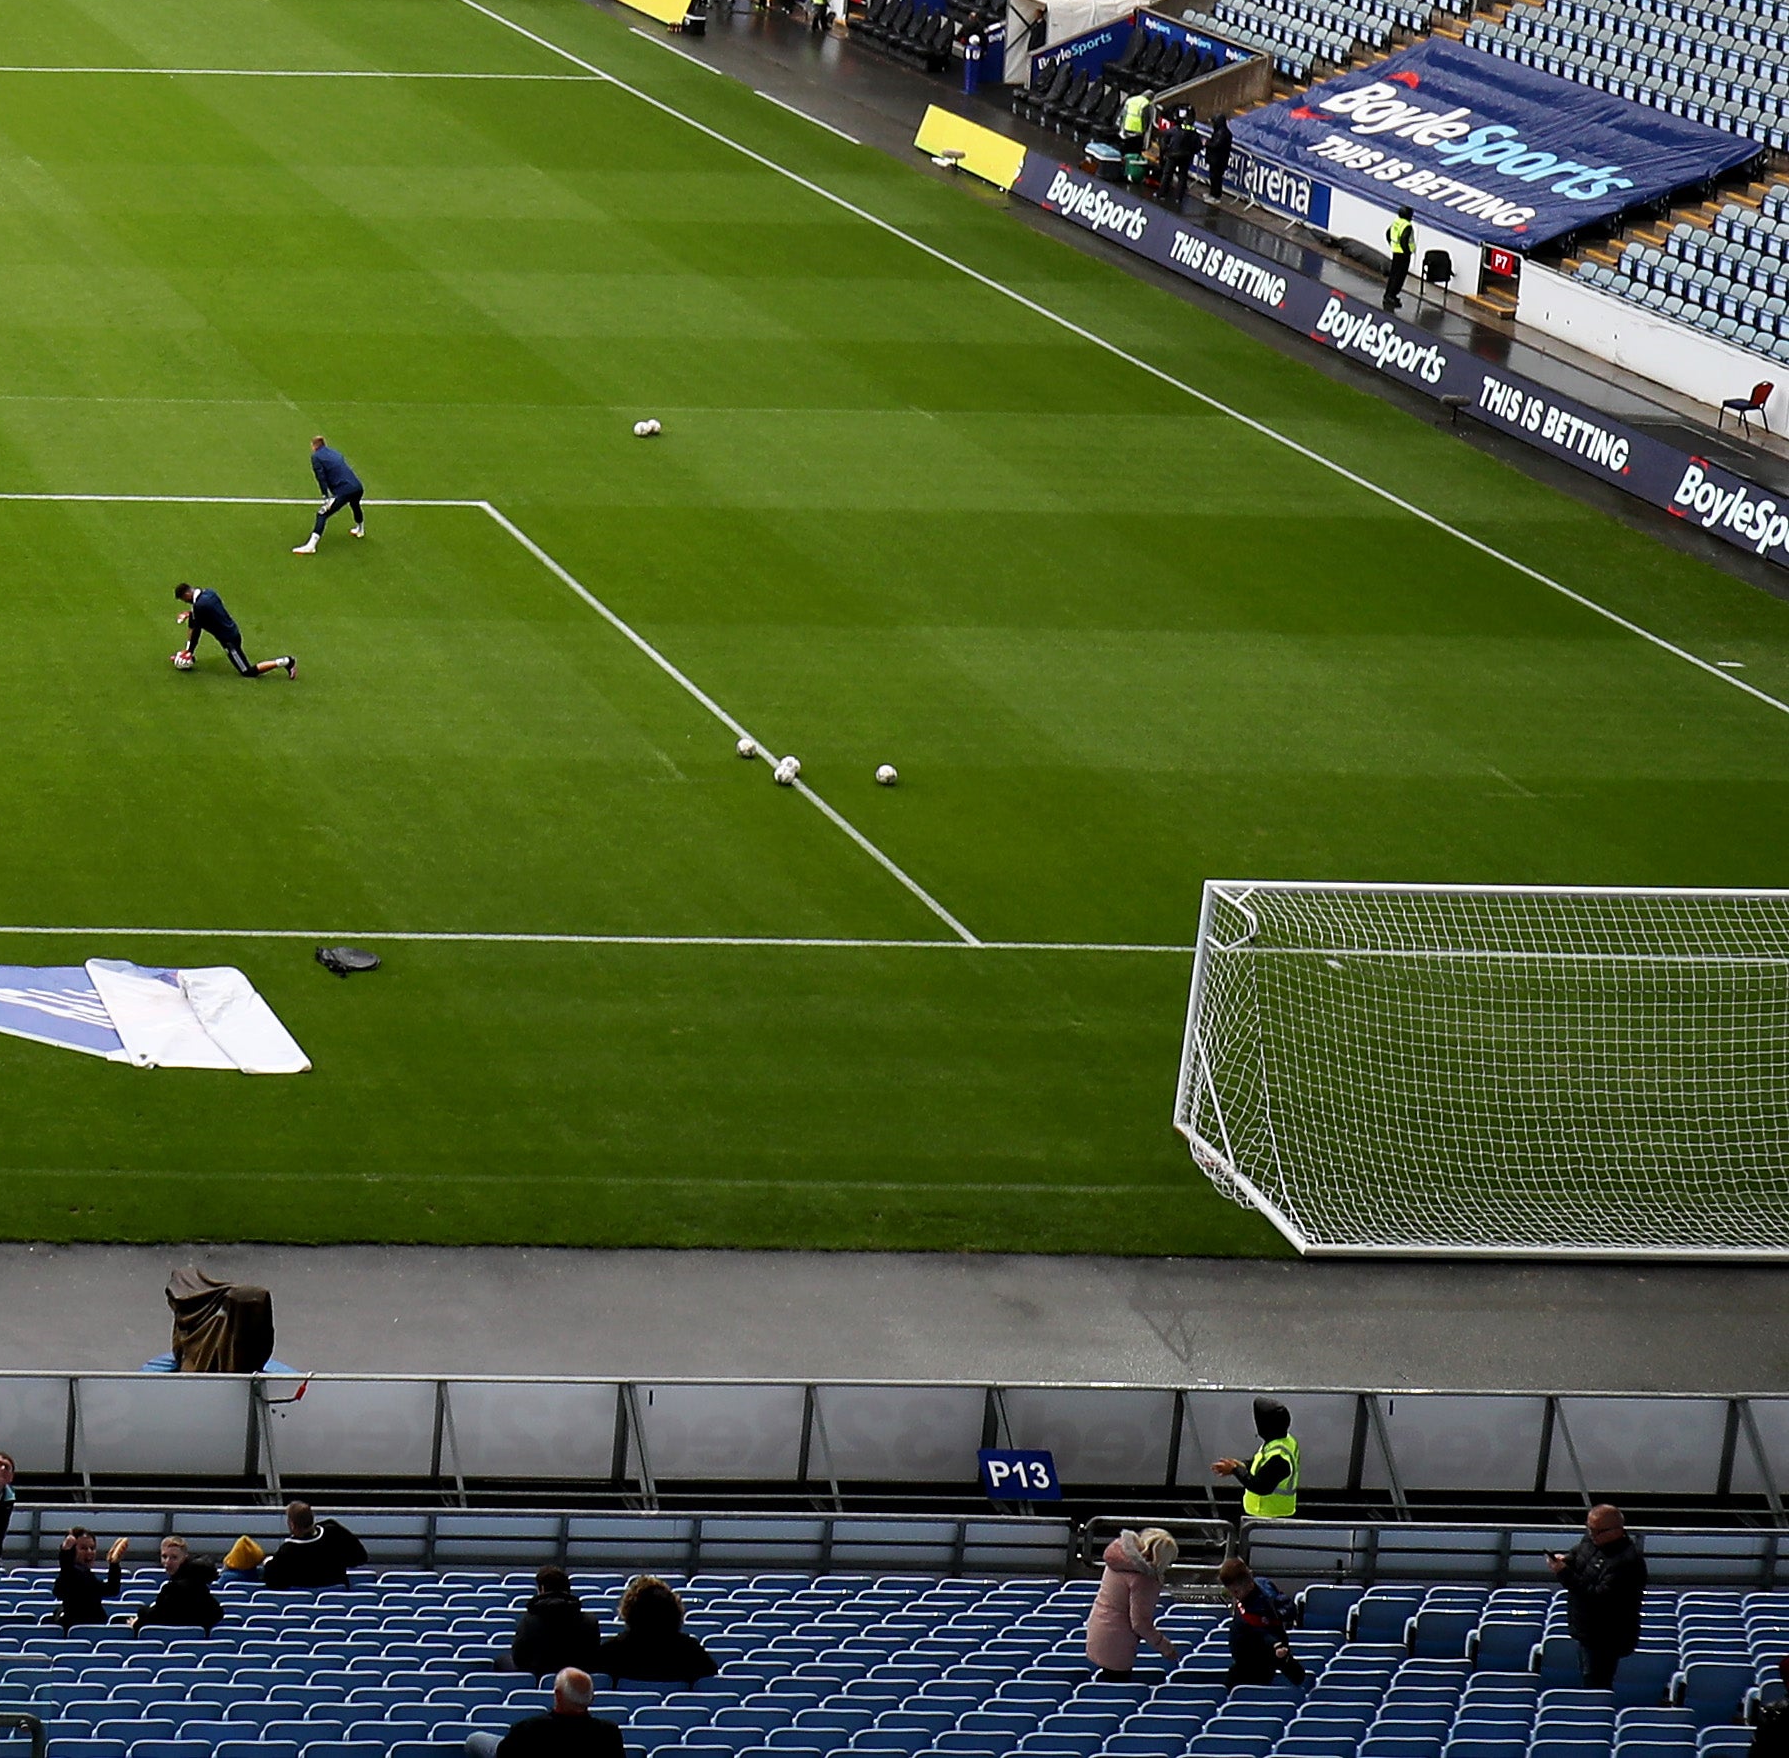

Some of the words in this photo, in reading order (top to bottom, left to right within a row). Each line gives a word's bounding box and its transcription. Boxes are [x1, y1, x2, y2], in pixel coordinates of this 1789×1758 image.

[1306, 134, 1385, 171] THIS
[1374, 157, 1414, 181] IS
[1319, 81, 1634, 200] BoyleSports
[1047, 169, 1148, 240] BoyleSports
[1245, 158, 1311, 216] arena
[1171, 230, 1200, 271] THIS
[1204, 245, 1223, 277] IS
[1494, 252, 1508, 269] P7
[1315, 296, 1448, 384] BoyleSports
[1478, 375, 1523, 423] THIS
[1521, 397, 1545, 432] IS
[1672, 462, 1789, 557] BoyleSp
[988, 1459, 1053, 1492] P13
